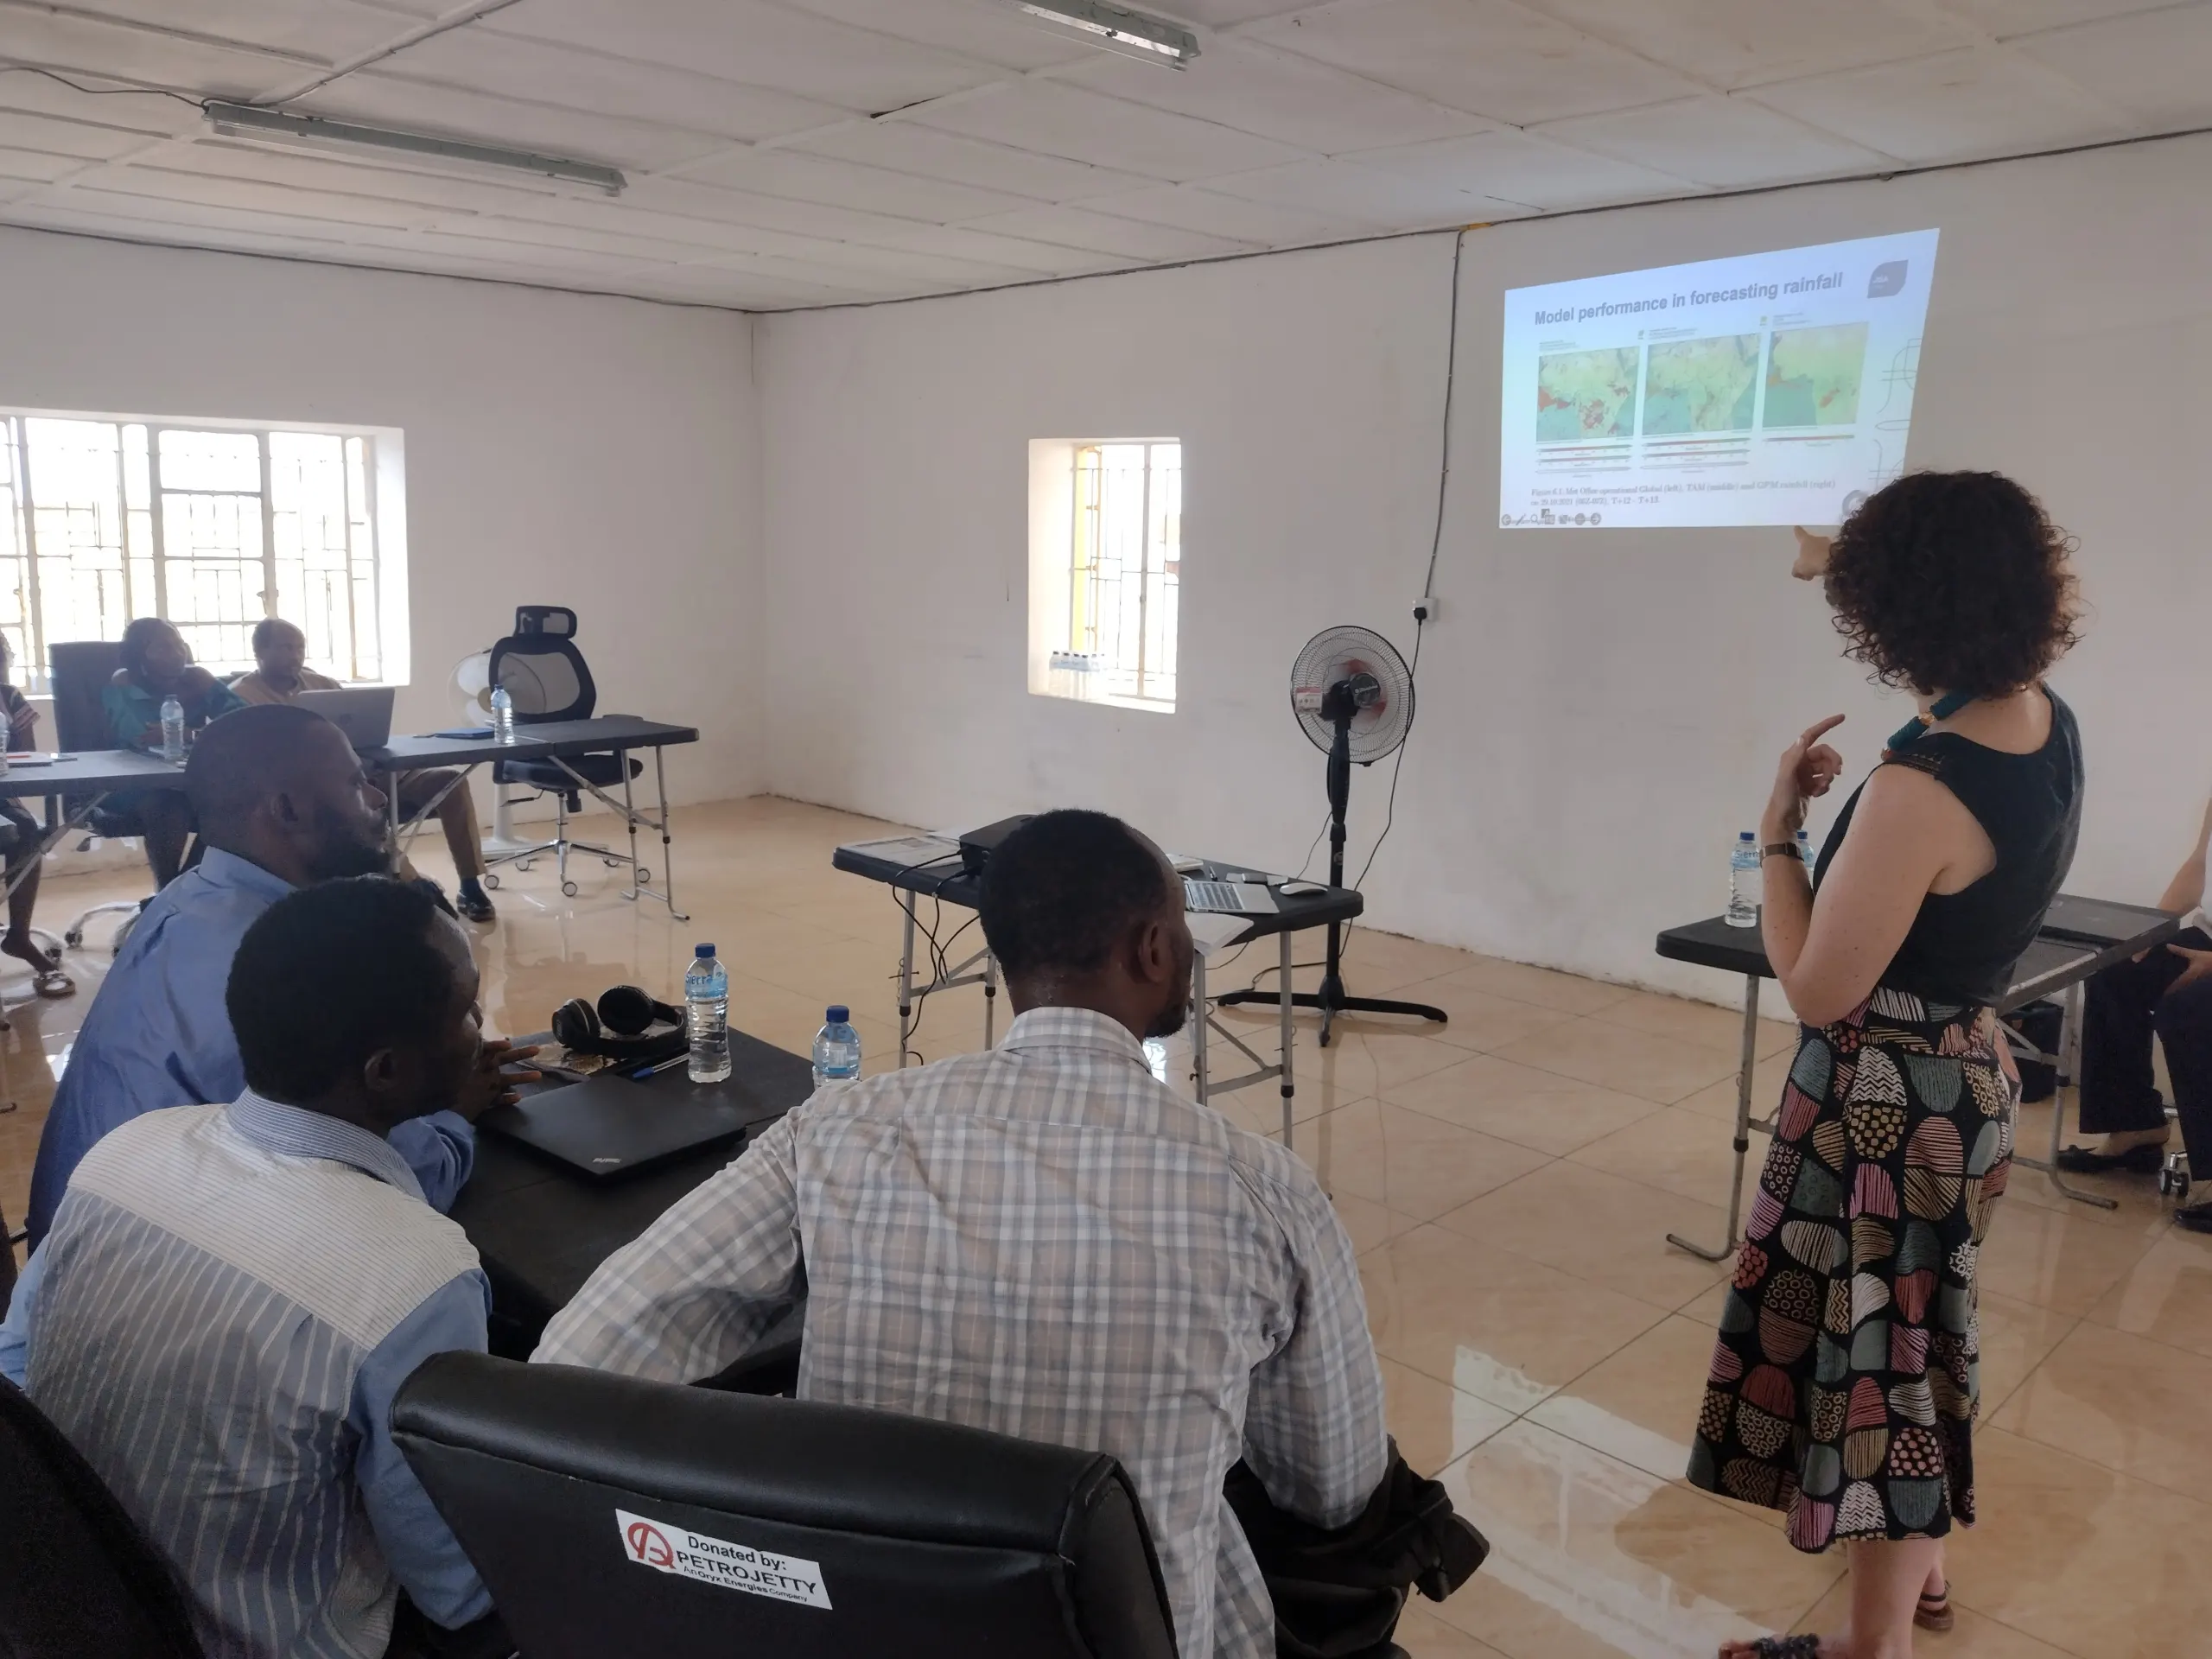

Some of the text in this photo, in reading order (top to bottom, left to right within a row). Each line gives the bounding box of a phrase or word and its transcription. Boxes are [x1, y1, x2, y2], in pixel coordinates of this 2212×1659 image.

[1535, 271, 1843, 326] Model performance in forecasting rainfall
[1580, 486, 1598, 495] Office
[1599, 485, 1637, 495] operational
[1639, 483, 1662, 493] Global
[1740, 481, 1755, 490] and
[1757, 480, 1778, 490] GPM
[1780, 480, 1808, 489] rainfall
[1809, 480, 1835, 490] (right)
[1611, 496, 1631, 505] T+12
[685, 973, 714, 986] Sierra
[688, 1535, 788, 1571] Donated by:
[677, 1550, 817, 1595] PETROJETTY
[724, 1577, 768, 1593] Energies
[769, 1587, 808, 1602] Company
